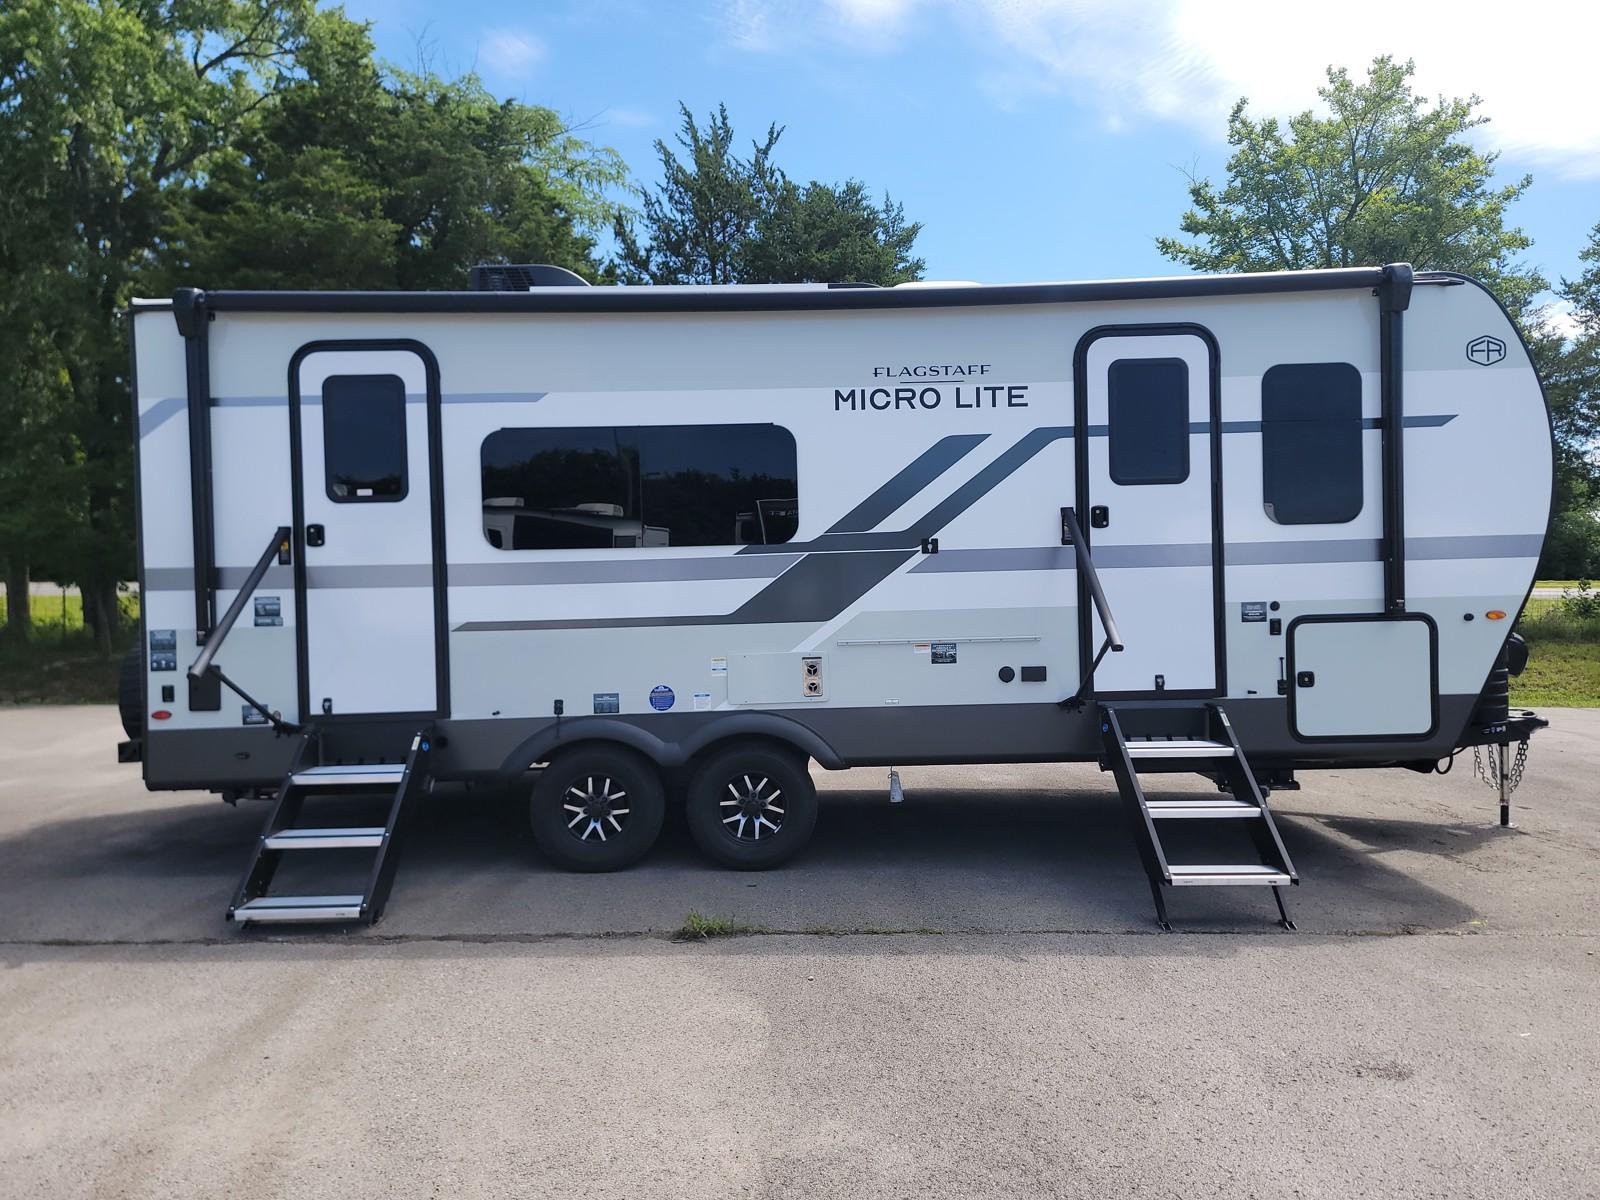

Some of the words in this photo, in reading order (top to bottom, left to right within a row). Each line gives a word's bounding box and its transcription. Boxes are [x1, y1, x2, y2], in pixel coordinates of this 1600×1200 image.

[873, 364, 991, 378] FLAGSTAFF
[834, 387, 941, 411] MICRO
[955, 385, 1029, 409] LITE
